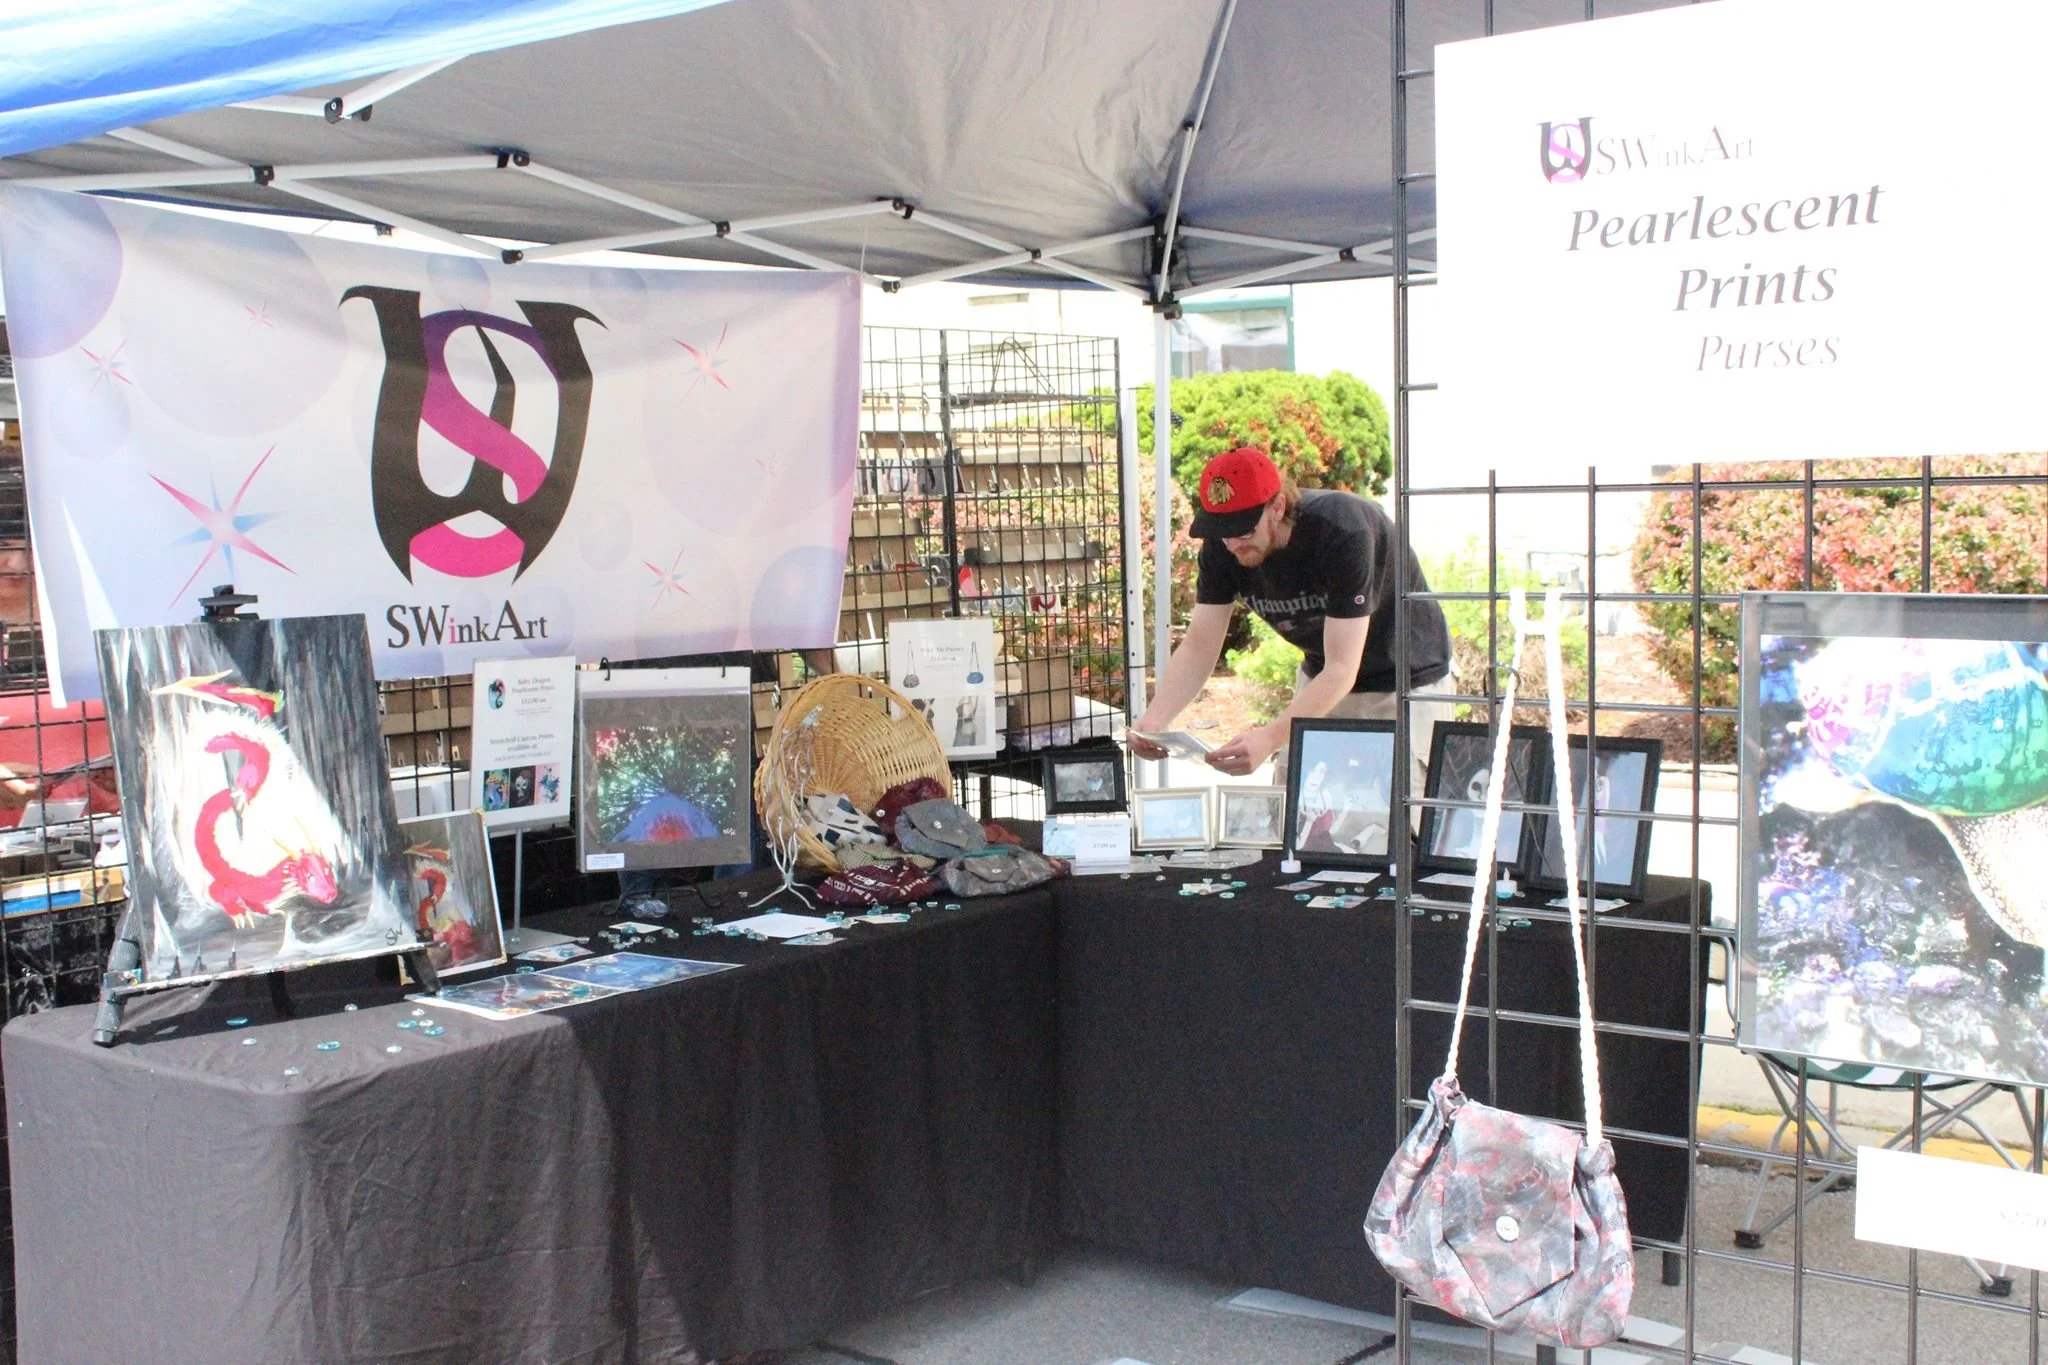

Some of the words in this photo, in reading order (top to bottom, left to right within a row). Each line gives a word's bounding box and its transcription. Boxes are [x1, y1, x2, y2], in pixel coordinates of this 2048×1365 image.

[1564, 183, 1887, 252] Pearlescent
[1673, 262, 1838, 312] Prints
[1696, 335, 1841, 371] Purses
[386, 599, 549, 649] SWinkArt
